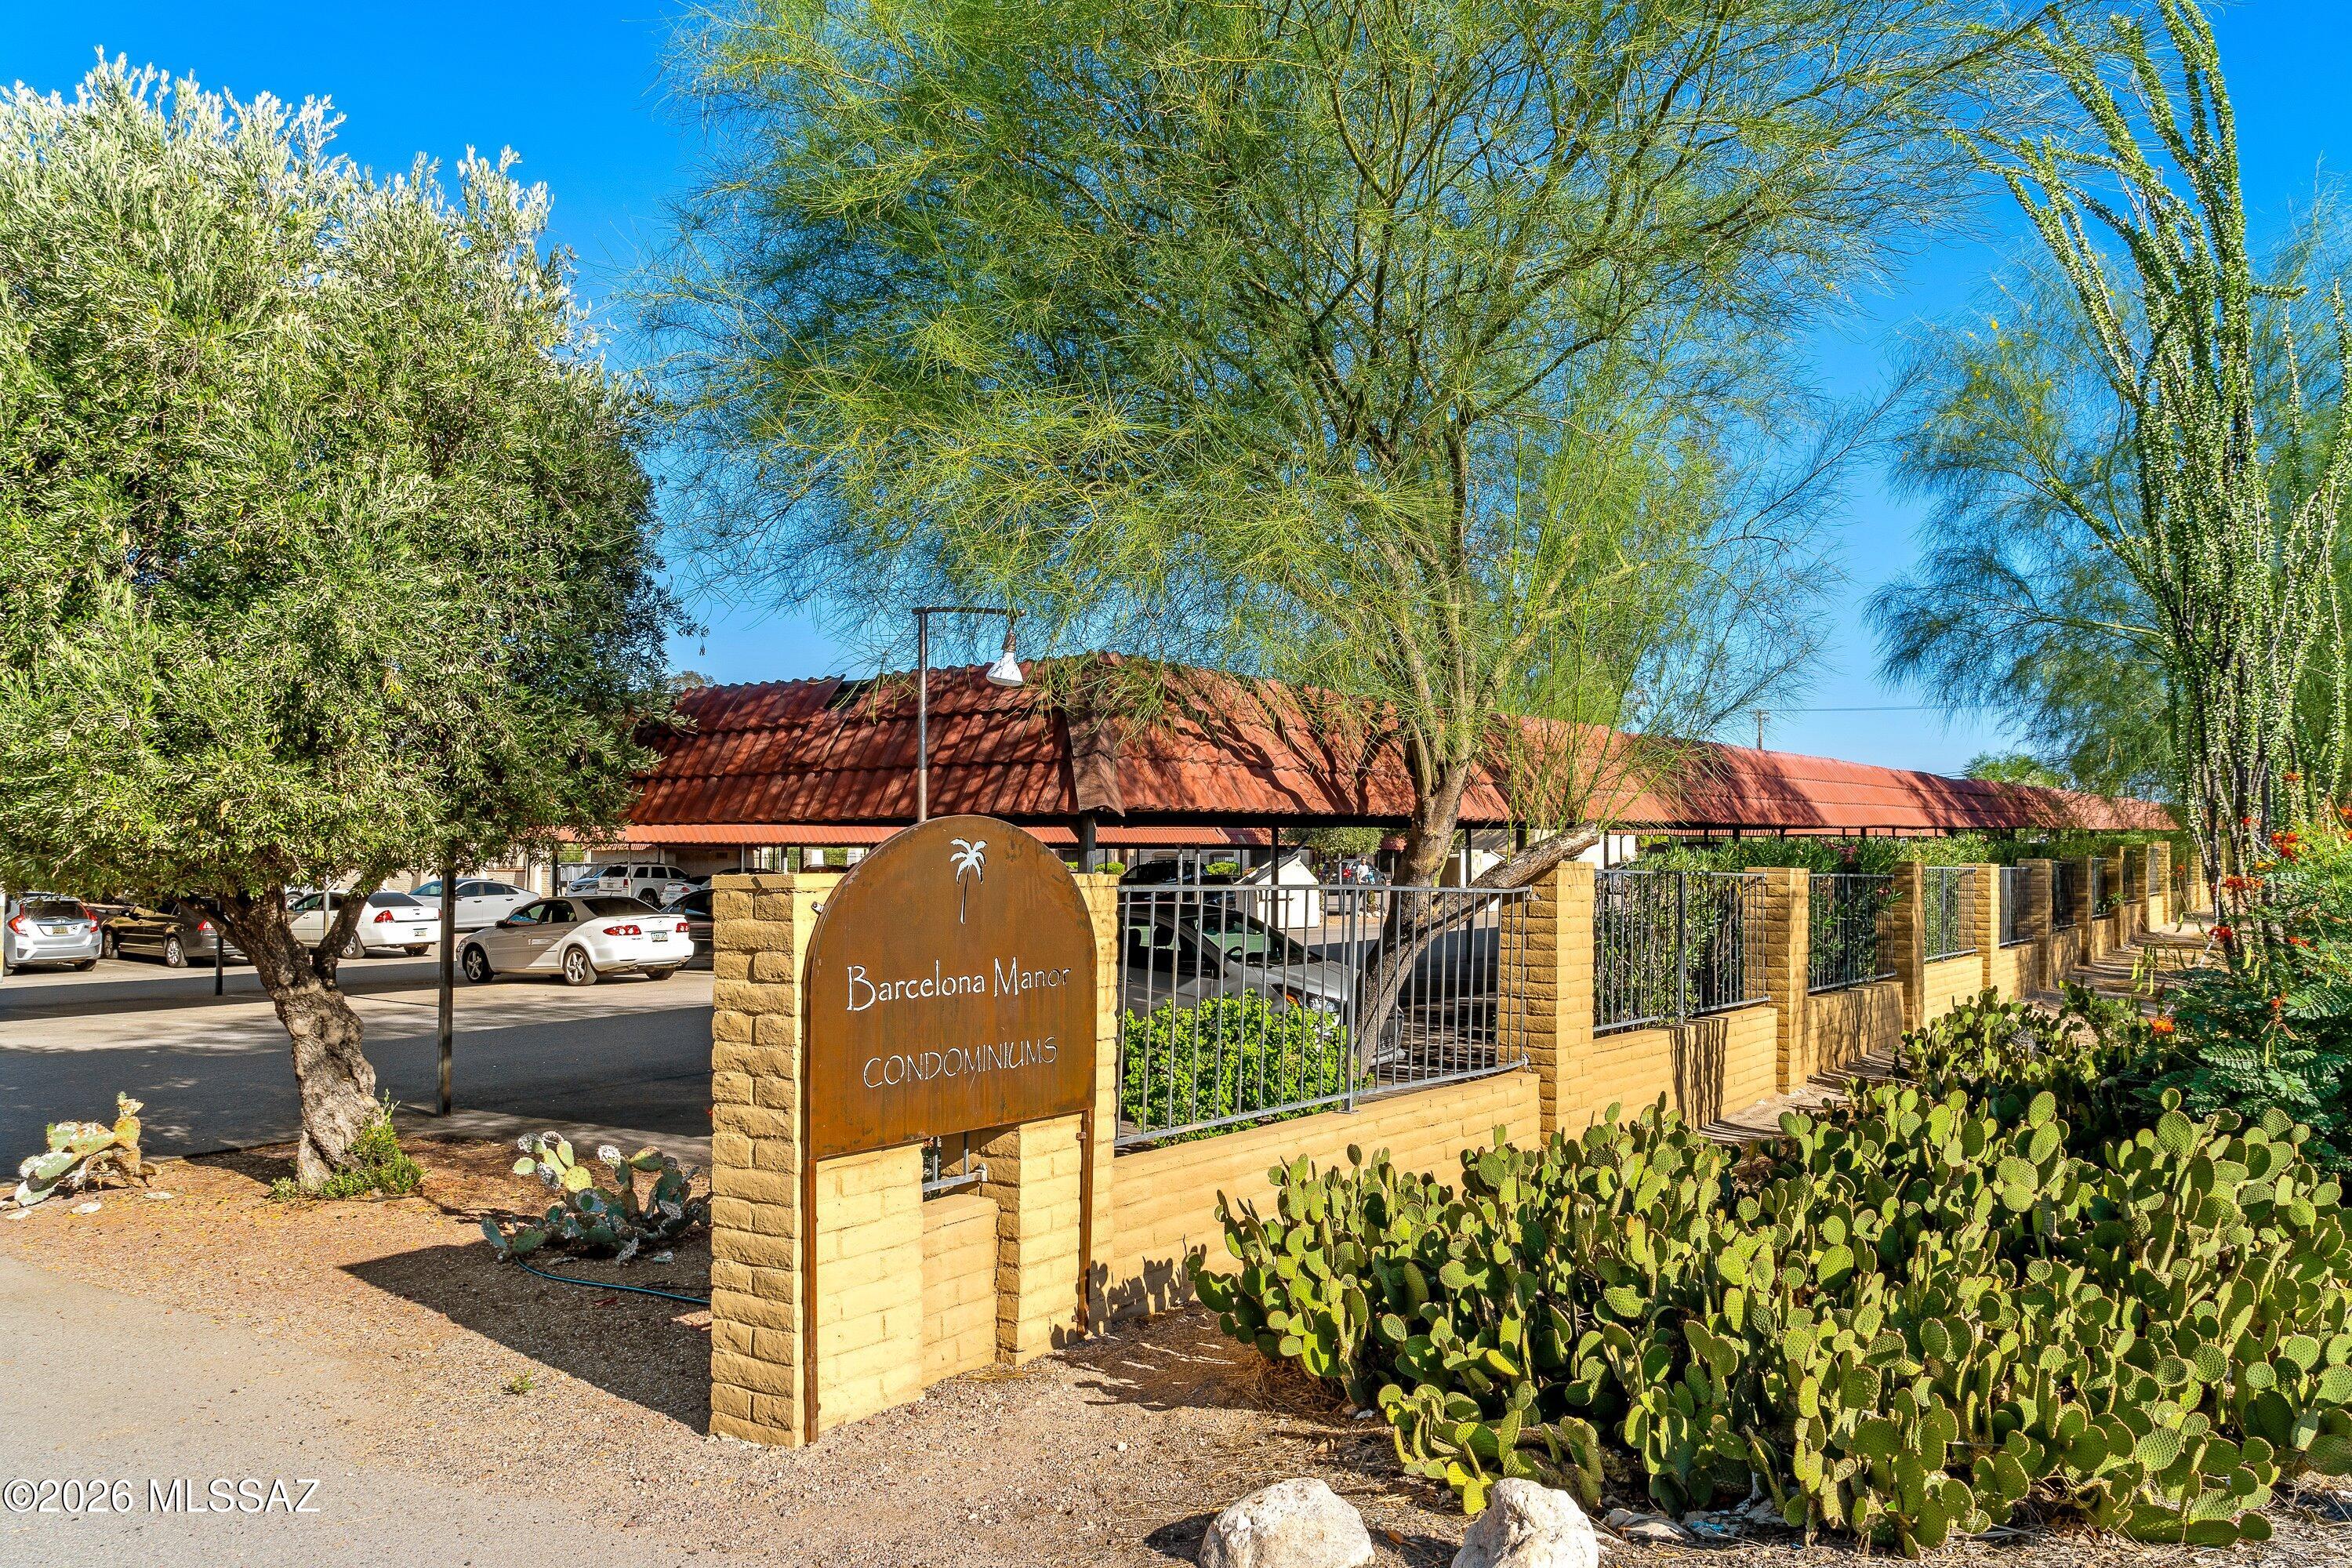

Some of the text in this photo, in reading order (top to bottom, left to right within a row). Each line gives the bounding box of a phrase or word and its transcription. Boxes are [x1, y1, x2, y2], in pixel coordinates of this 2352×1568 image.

[847, 956, 1071, 1011] Barcelona Manor
[863, 1036, 1058, 1088] CONDOMINIUMS
